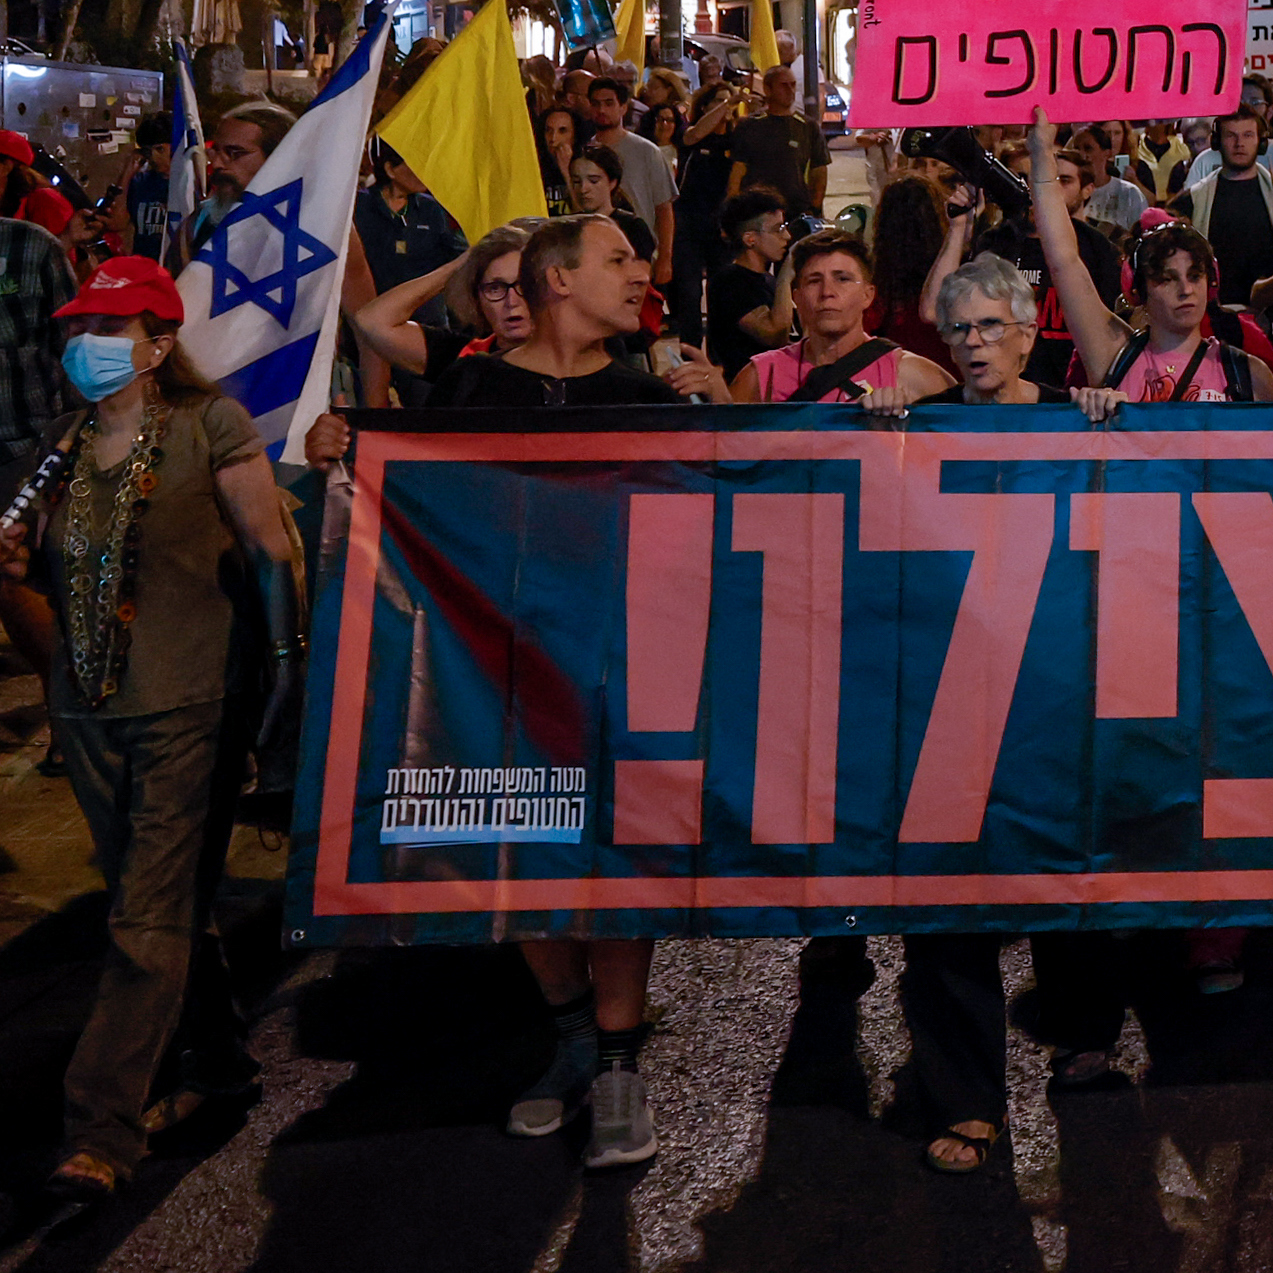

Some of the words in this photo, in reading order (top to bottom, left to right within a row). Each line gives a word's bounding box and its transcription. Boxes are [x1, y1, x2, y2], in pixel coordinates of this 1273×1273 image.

[892, 21, 1228, 106] החטופים
[1018, 269, 1042, 285] OME
[384, 765, 455, 795] להחזרת
[458, 766, 546, 794] המשפחות
[550, 766, 586, 793] מטה
[381, 798, 486, 833] והנעדרים
[491, 797, 586, 832] החטופים
